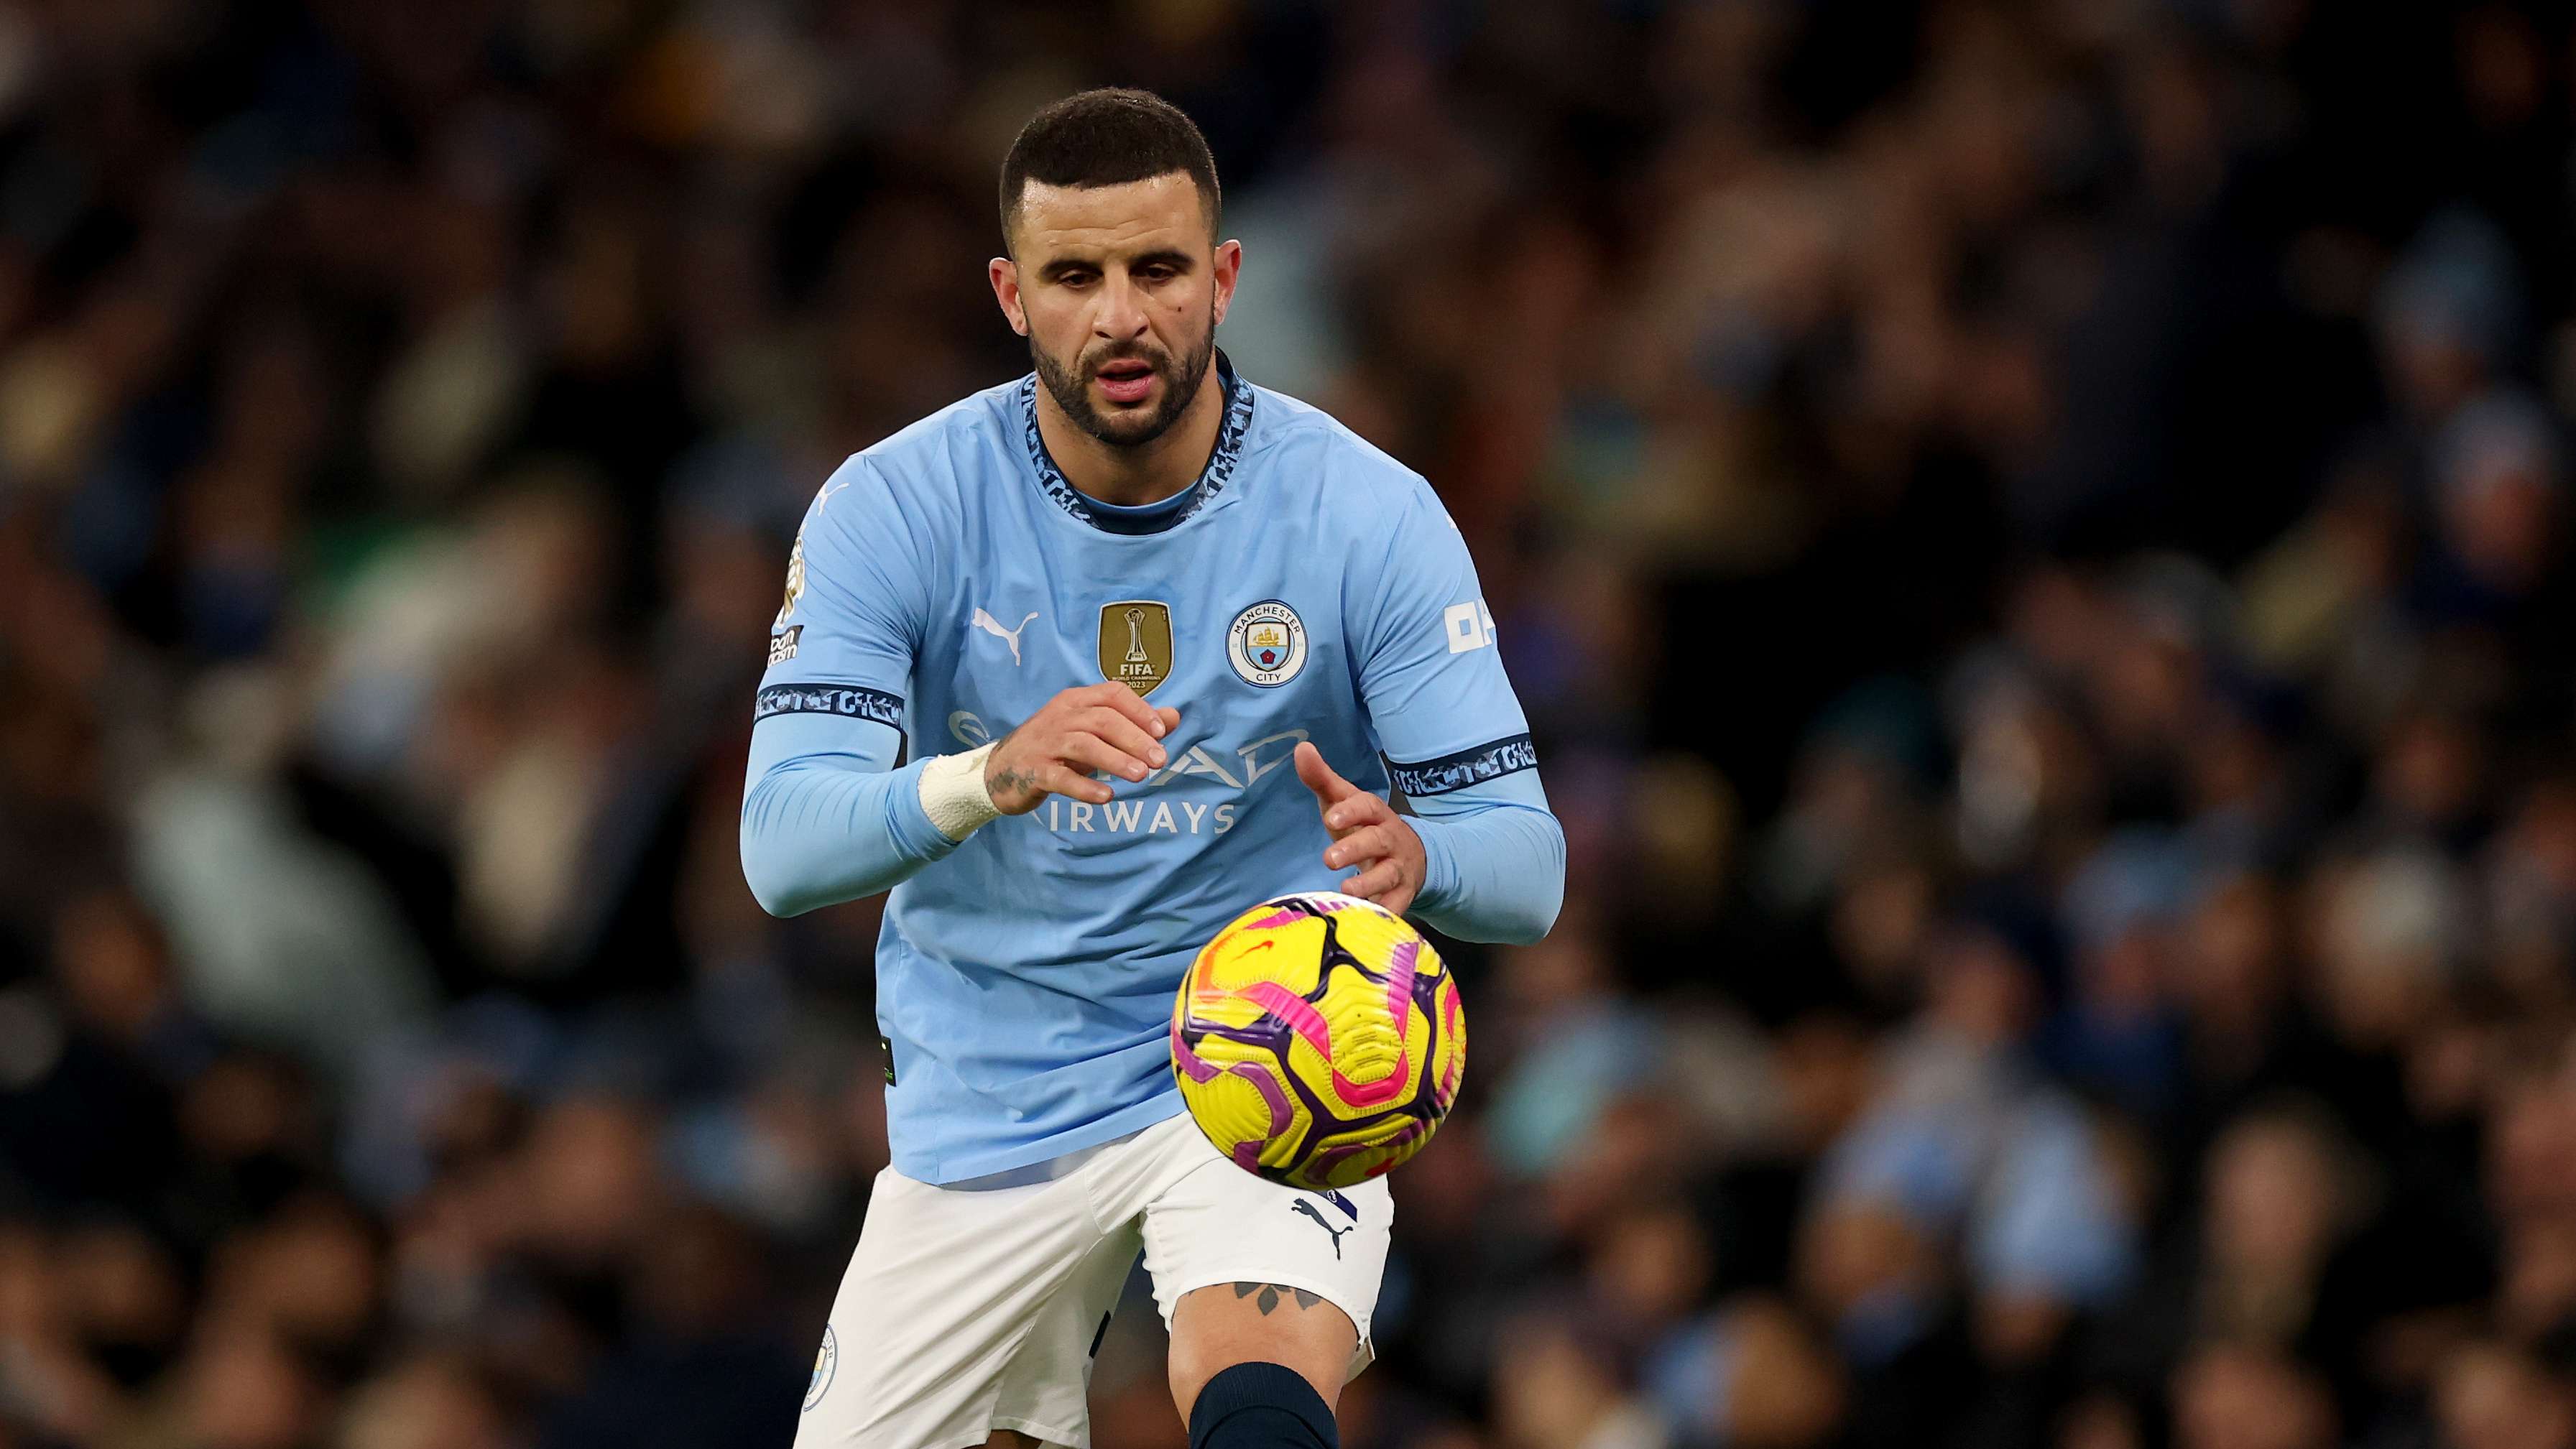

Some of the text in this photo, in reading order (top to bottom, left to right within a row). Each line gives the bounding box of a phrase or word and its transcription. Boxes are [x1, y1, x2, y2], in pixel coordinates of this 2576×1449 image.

[1234, 606, 1301, 634] MANCHESTER
[770, 629, 795, 652] oom
[1120, 663, 1153, 675] FIFA
[1256, 673, 1281, 682] CITY
[1030, 800, 1235, 834] IRWAYS
